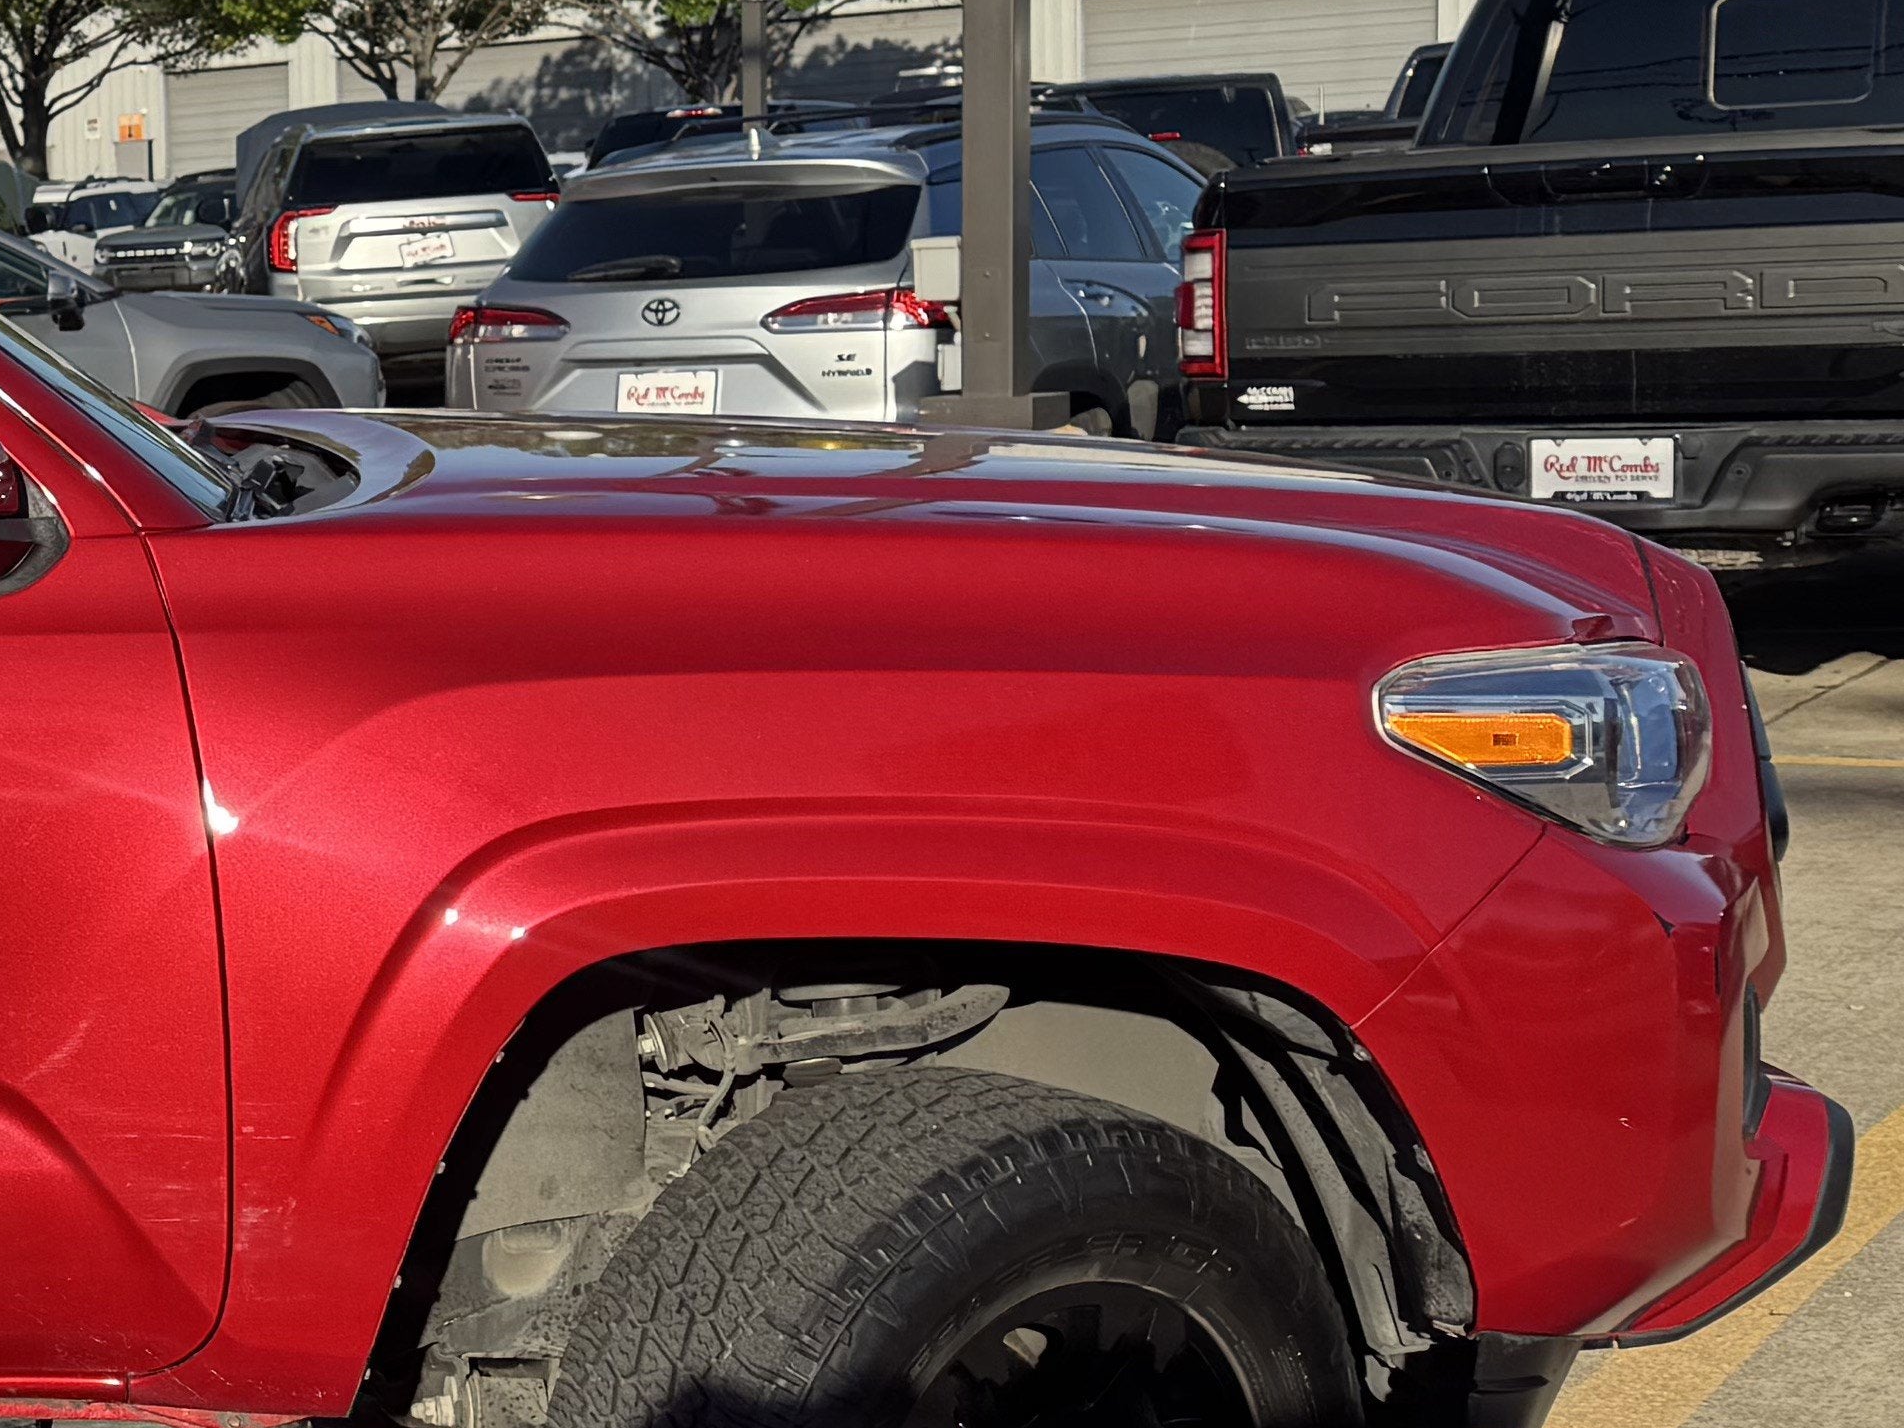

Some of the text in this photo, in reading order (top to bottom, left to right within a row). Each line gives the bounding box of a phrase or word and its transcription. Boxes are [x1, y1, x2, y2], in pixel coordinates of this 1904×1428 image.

[1306, 264, 1904, 324] FORD
[1543, 454, 1660, 480] Red McCombs
